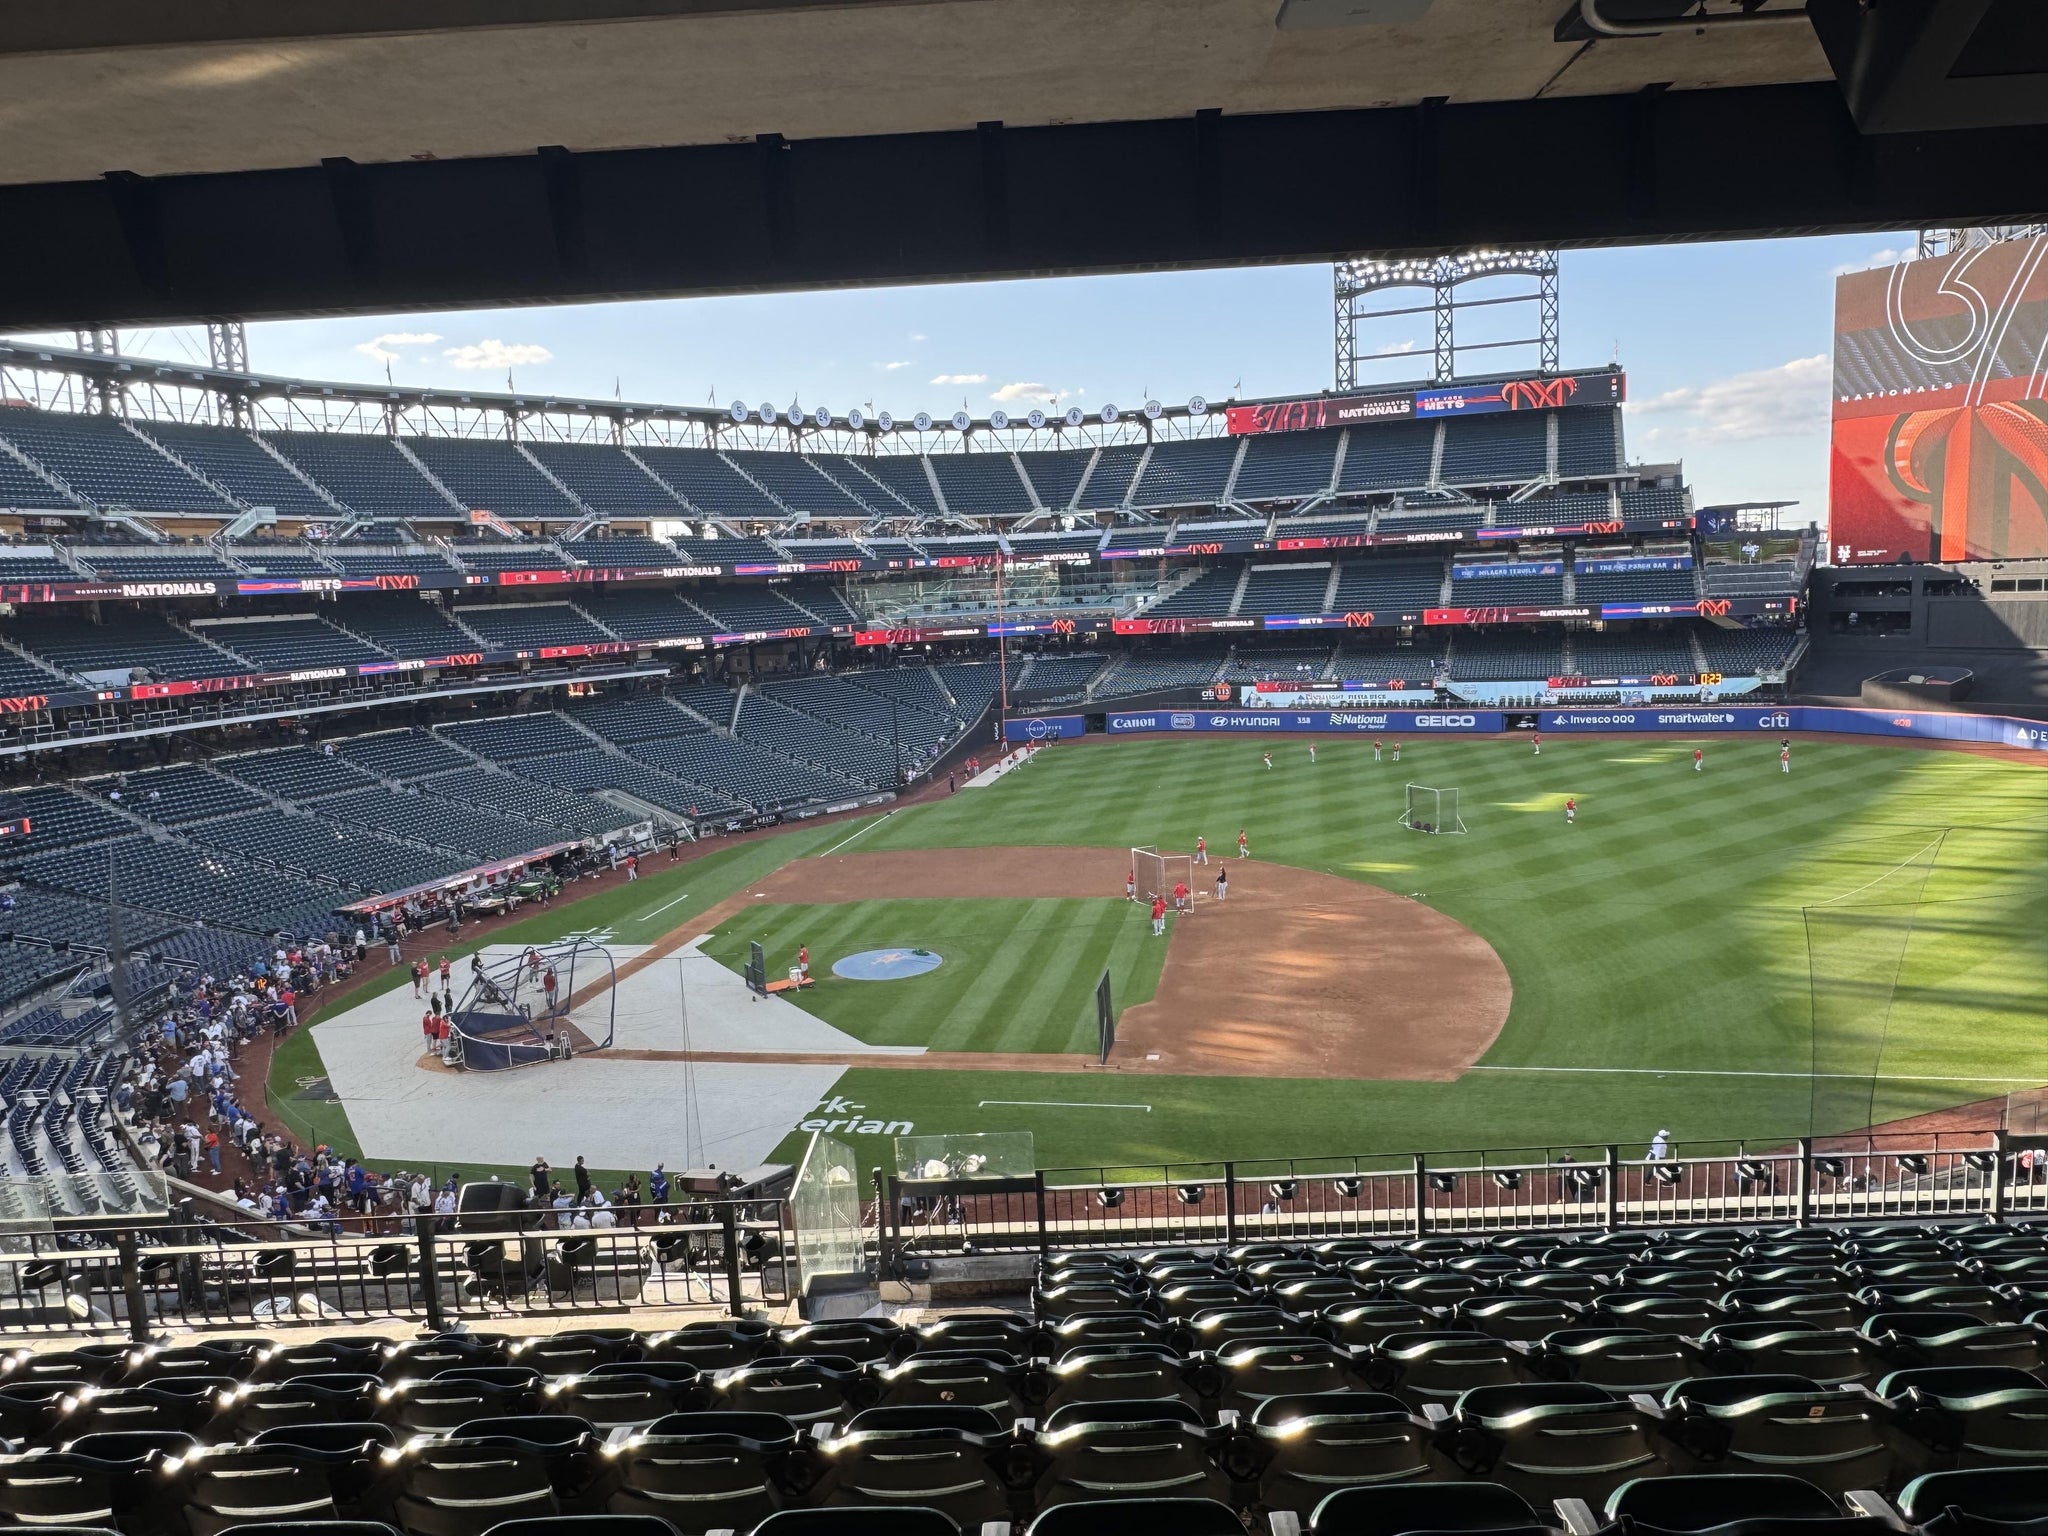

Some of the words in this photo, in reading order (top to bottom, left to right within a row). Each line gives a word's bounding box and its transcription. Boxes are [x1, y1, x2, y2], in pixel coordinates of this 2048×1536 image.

[1841, 382, 1953, 402] NATIONALS
[1191, 401, 1202, 410] 42
[1424, 400, 1465, 411] METS
[736, 406, 743, 416] 5
[818, 411, 828, 421] 24
[1338, 404, 1411, 419] NATIONALS
[852, 415, 859, 424] 17
[918, 418, 927, 426] 31
[957, 417, 966, 425] 41
[995, 416, 1004, 424] 14
[1031, 415, 1042, 424] 37
[1407, 531, 1463, 542] NATIONALS
[1522, 527, 1555, 536] METS
[1043, 552, 1090, 561] NATIONALS
[663, 566, 722, 577] NATIONALS
[778, 563, 806, 573] METS
[123, 582, 216, 597] NATIONALS
[301, 579, 342, 590] METS
[744, 632, 767, 641] METS
[658, 637, 703, 648] NATIONALS
[399, 660, 426, 670] METS
[291, 668, 347, 682] NATIONALS
[1700, 673, 1722, 685] 0:23
[1113, 718, 1156, 729] Canon
[1231, 717, 1280, 726] HYUNDAI
[1415, 715, 1476, 727] GEICO
[1570, 715, 1611, 725] Invesco
[1612, 714, 1635, 724] QQQ
[1658, 714, 1725, 724] smartwater
[1759, 713, 1790, 728] citi
[1893, 718, 1912, 727] 408
